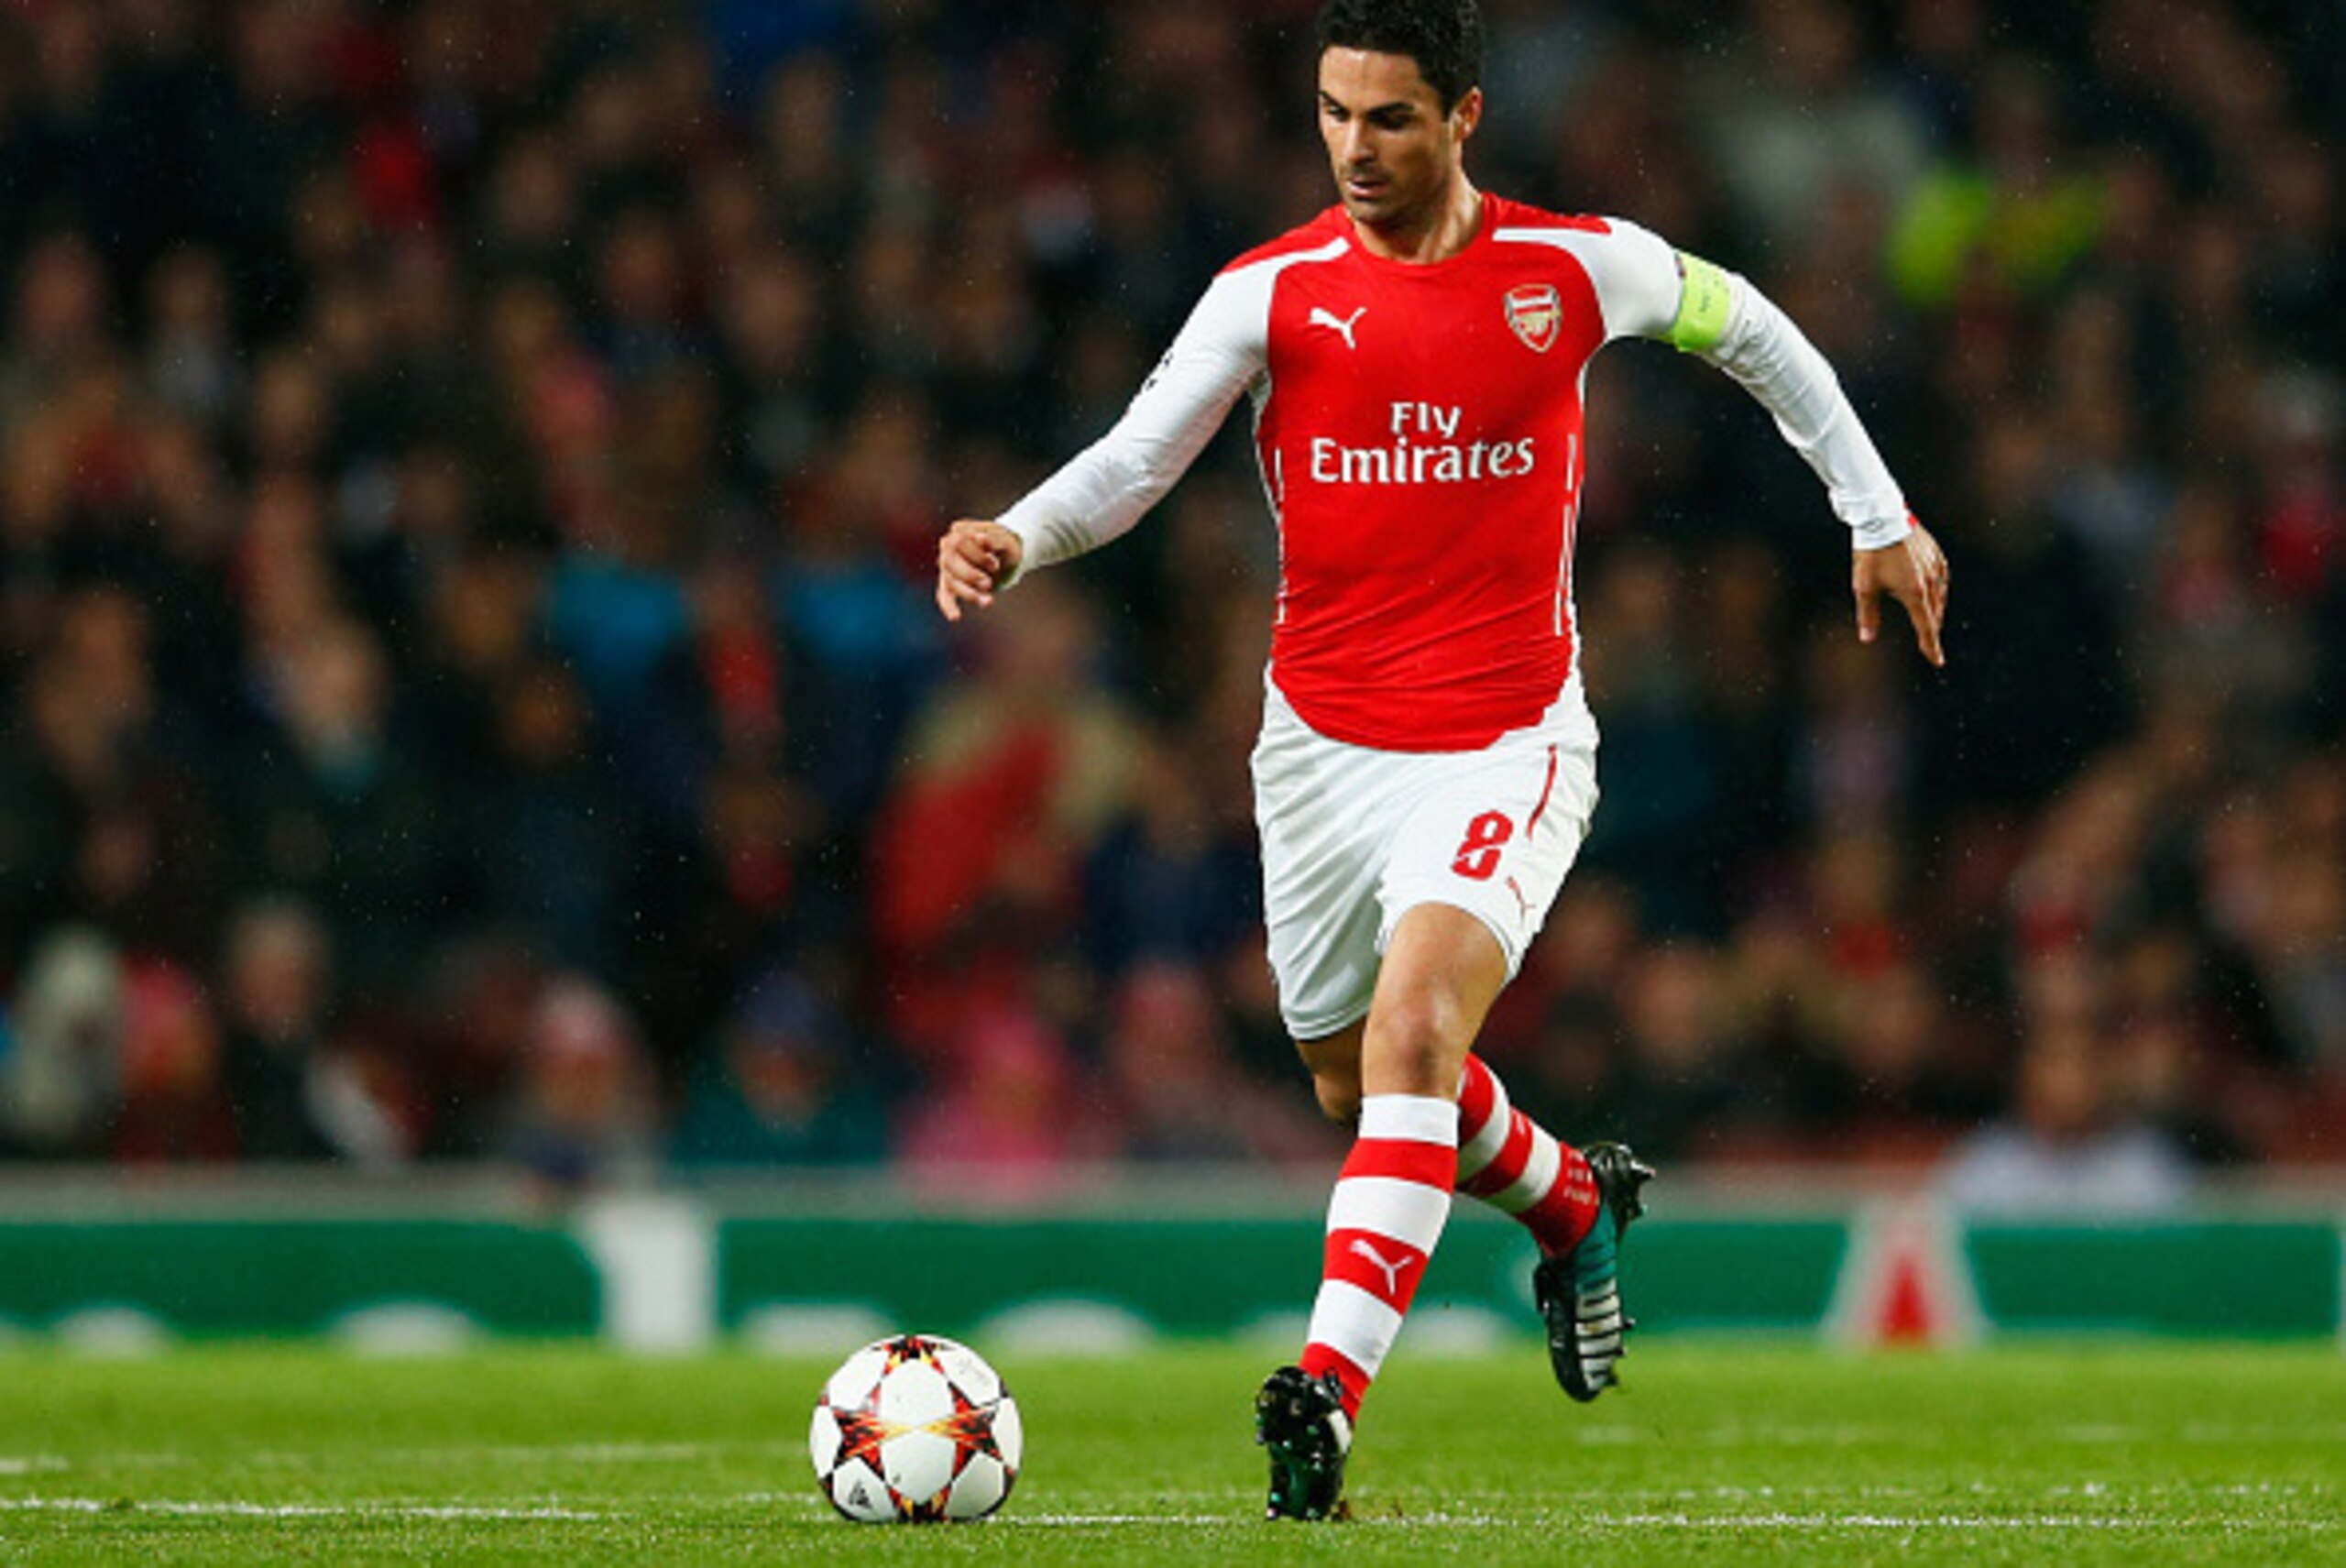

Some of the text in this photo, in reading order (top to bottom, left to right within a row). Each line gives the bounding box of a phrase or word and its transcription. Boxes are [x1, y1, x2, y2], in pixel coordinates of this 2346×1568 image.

[1390, 401, 1462, 438] Fly
[1310, 435, 1535, 484] Emirates
[1451, 808, 1514, 881] 8
